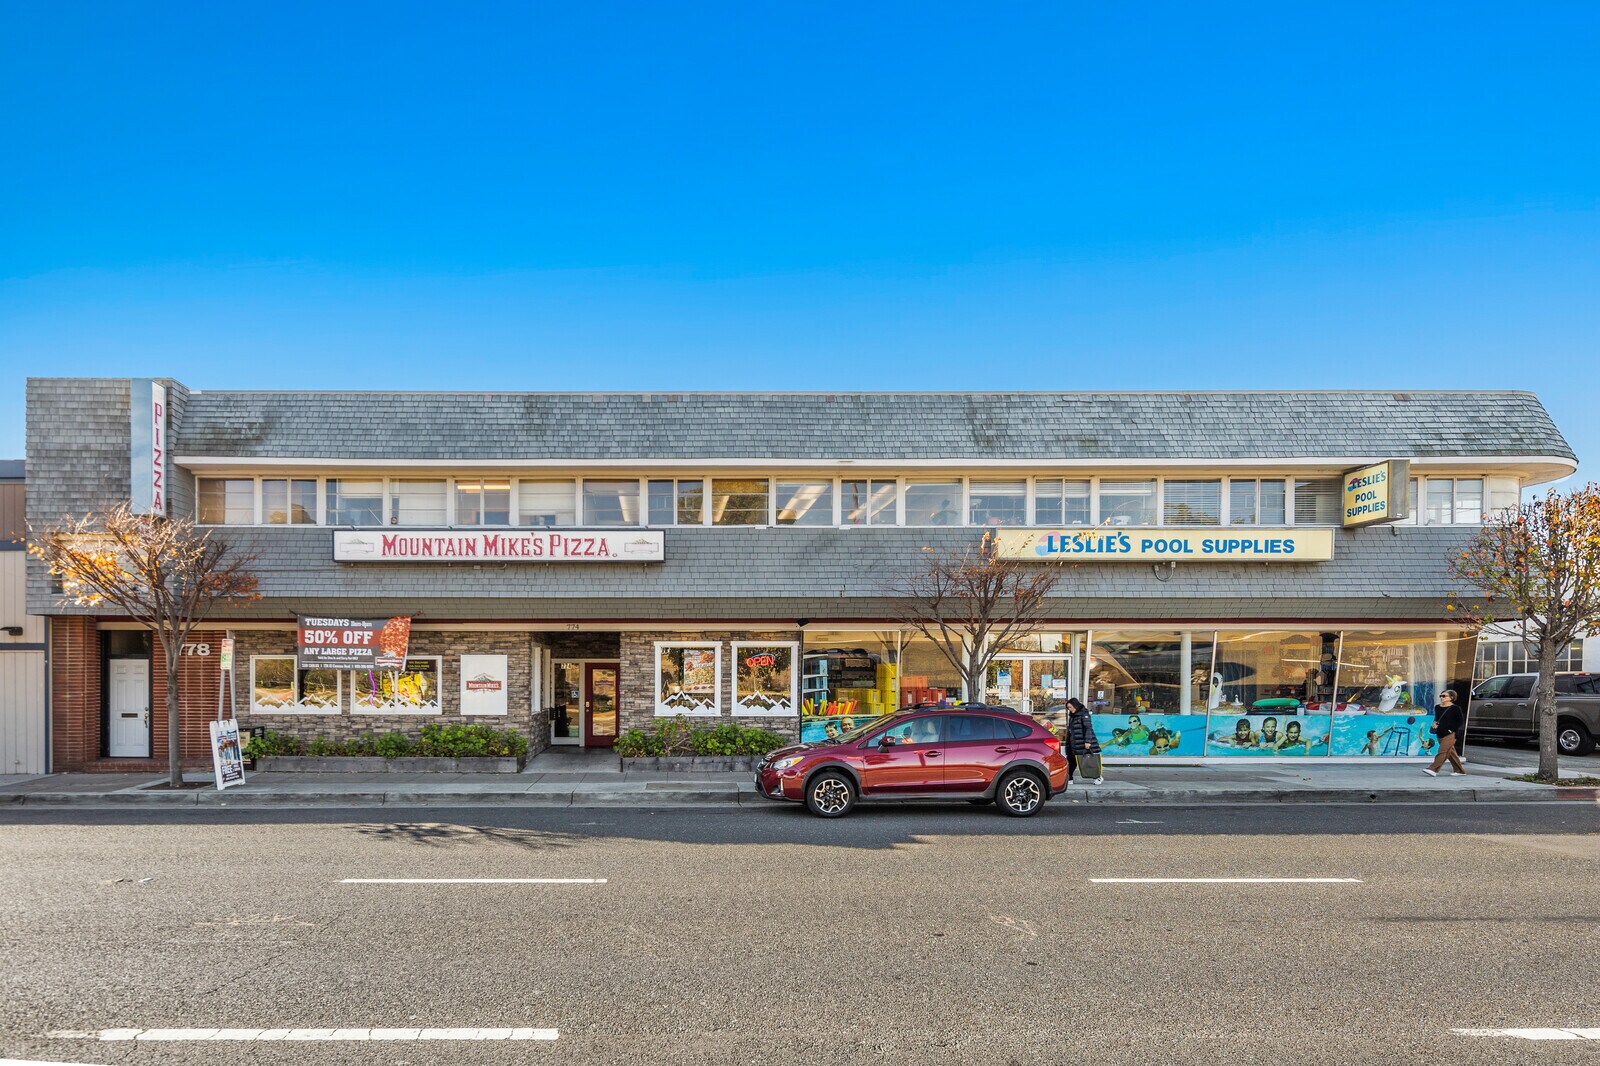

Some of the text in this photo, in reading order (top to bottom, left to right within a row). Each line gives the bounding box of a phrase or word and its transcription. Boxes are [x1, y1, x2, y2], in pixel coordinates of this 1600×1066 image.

[154, 402, 163, 510] PIZZA
[1352, 470, 1386, 489] LESLIE'S
[1355, 490, 1377, 503] POOL
[1346, 500, 1386, 518] SUPPLIES
[381, 532, 610, 557] MOUNTAIN MIKE'S PIZZA
[1047, 531, 1295, 554] LESLIE'S POOL SUPPLIES
[305, 618, 350, 627] TUESDAYS
[566, 623, 580, 631] 774
[304, 630, 374, 645] 50% OFF
[320, 648, 348, 656] LARGE
[348, 648, 373, 656] PIZZA
[746, 655, 774, 669] OPEN
